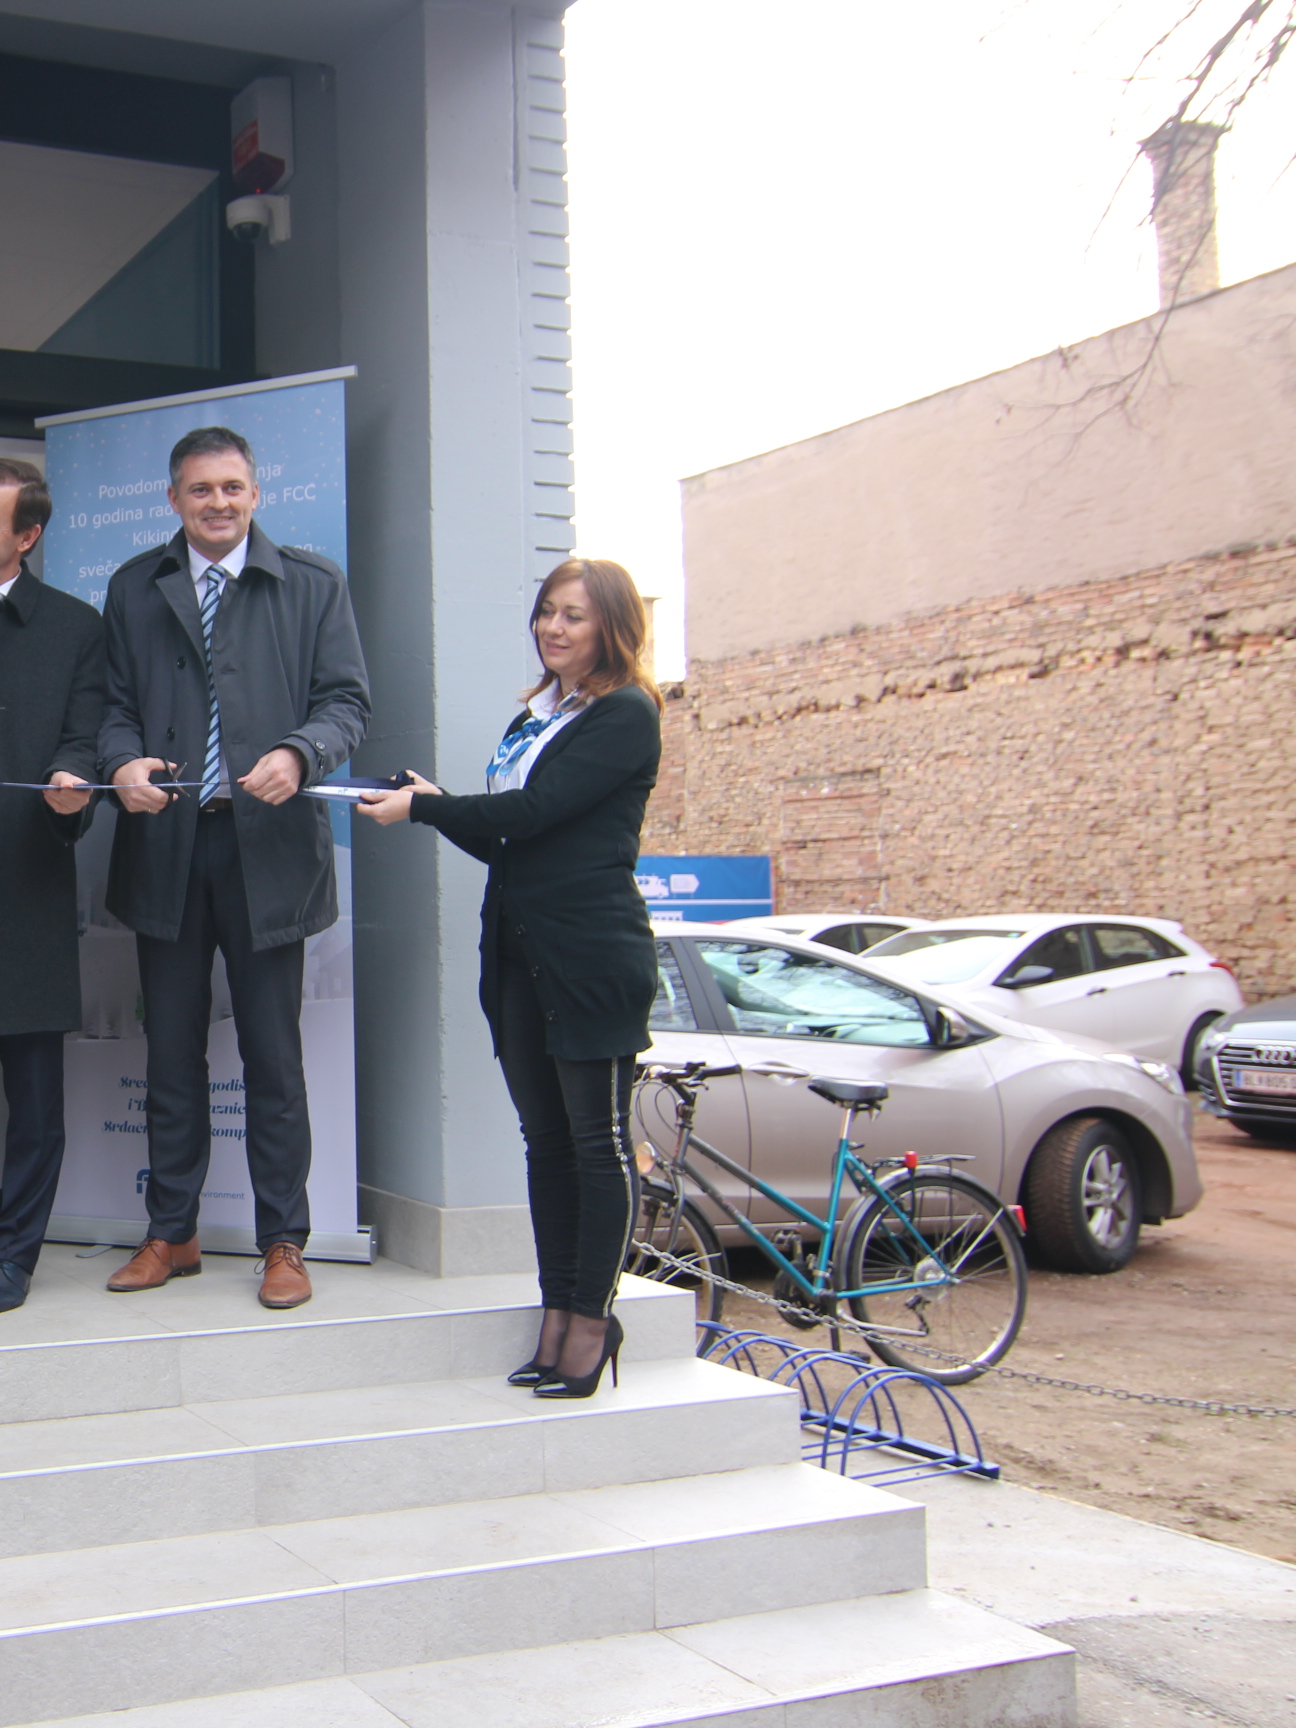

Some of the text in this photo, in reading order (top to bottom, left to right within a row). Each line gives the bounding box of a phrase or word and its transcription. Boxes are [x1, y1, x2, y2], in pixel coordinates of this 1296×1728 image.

[98, 462, 281, 499] Povodom nja
[69, 512, 87, 528] 10
[92, 508, 144, 529] godina
[149, 504, 174, 518] rad
[283, 483, 317, 503] FCC
[132, 526, 180, 546] Kikind
[78, 559, 122, 578] sveča
[90, 589, 107, 606] pr
[208, 1102, 246, 1115] aznic
[209, 1126, 247, 1141] komp
[200, 1190, 245, 1200] nvironment
